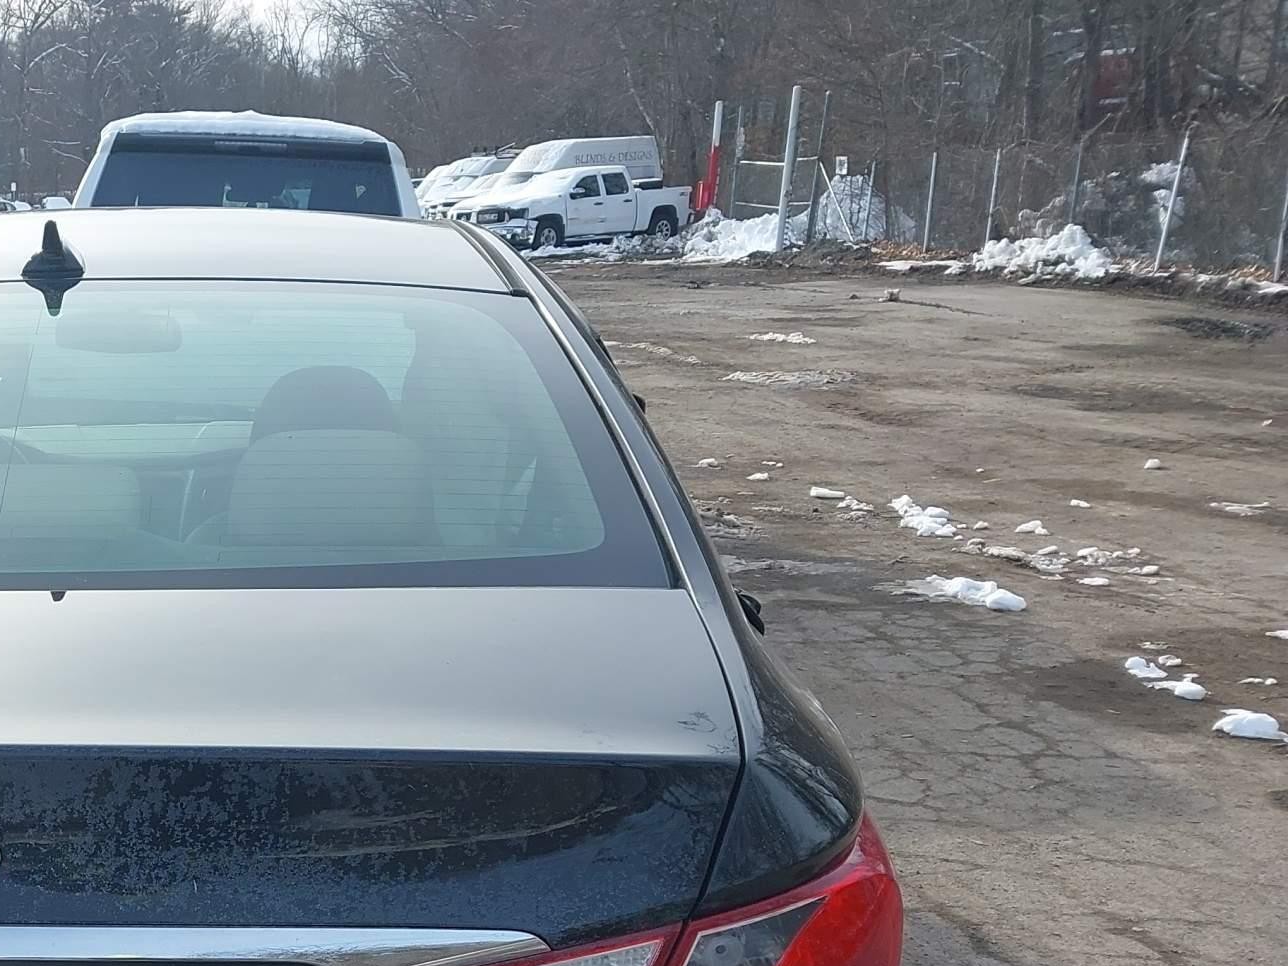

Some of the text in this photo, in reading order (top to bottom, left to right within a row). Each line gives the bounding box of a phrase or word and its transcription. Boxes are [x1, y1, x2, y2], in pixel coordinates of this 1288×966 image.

[575, 149, 654, 165] BLINDS & DESIGNS
